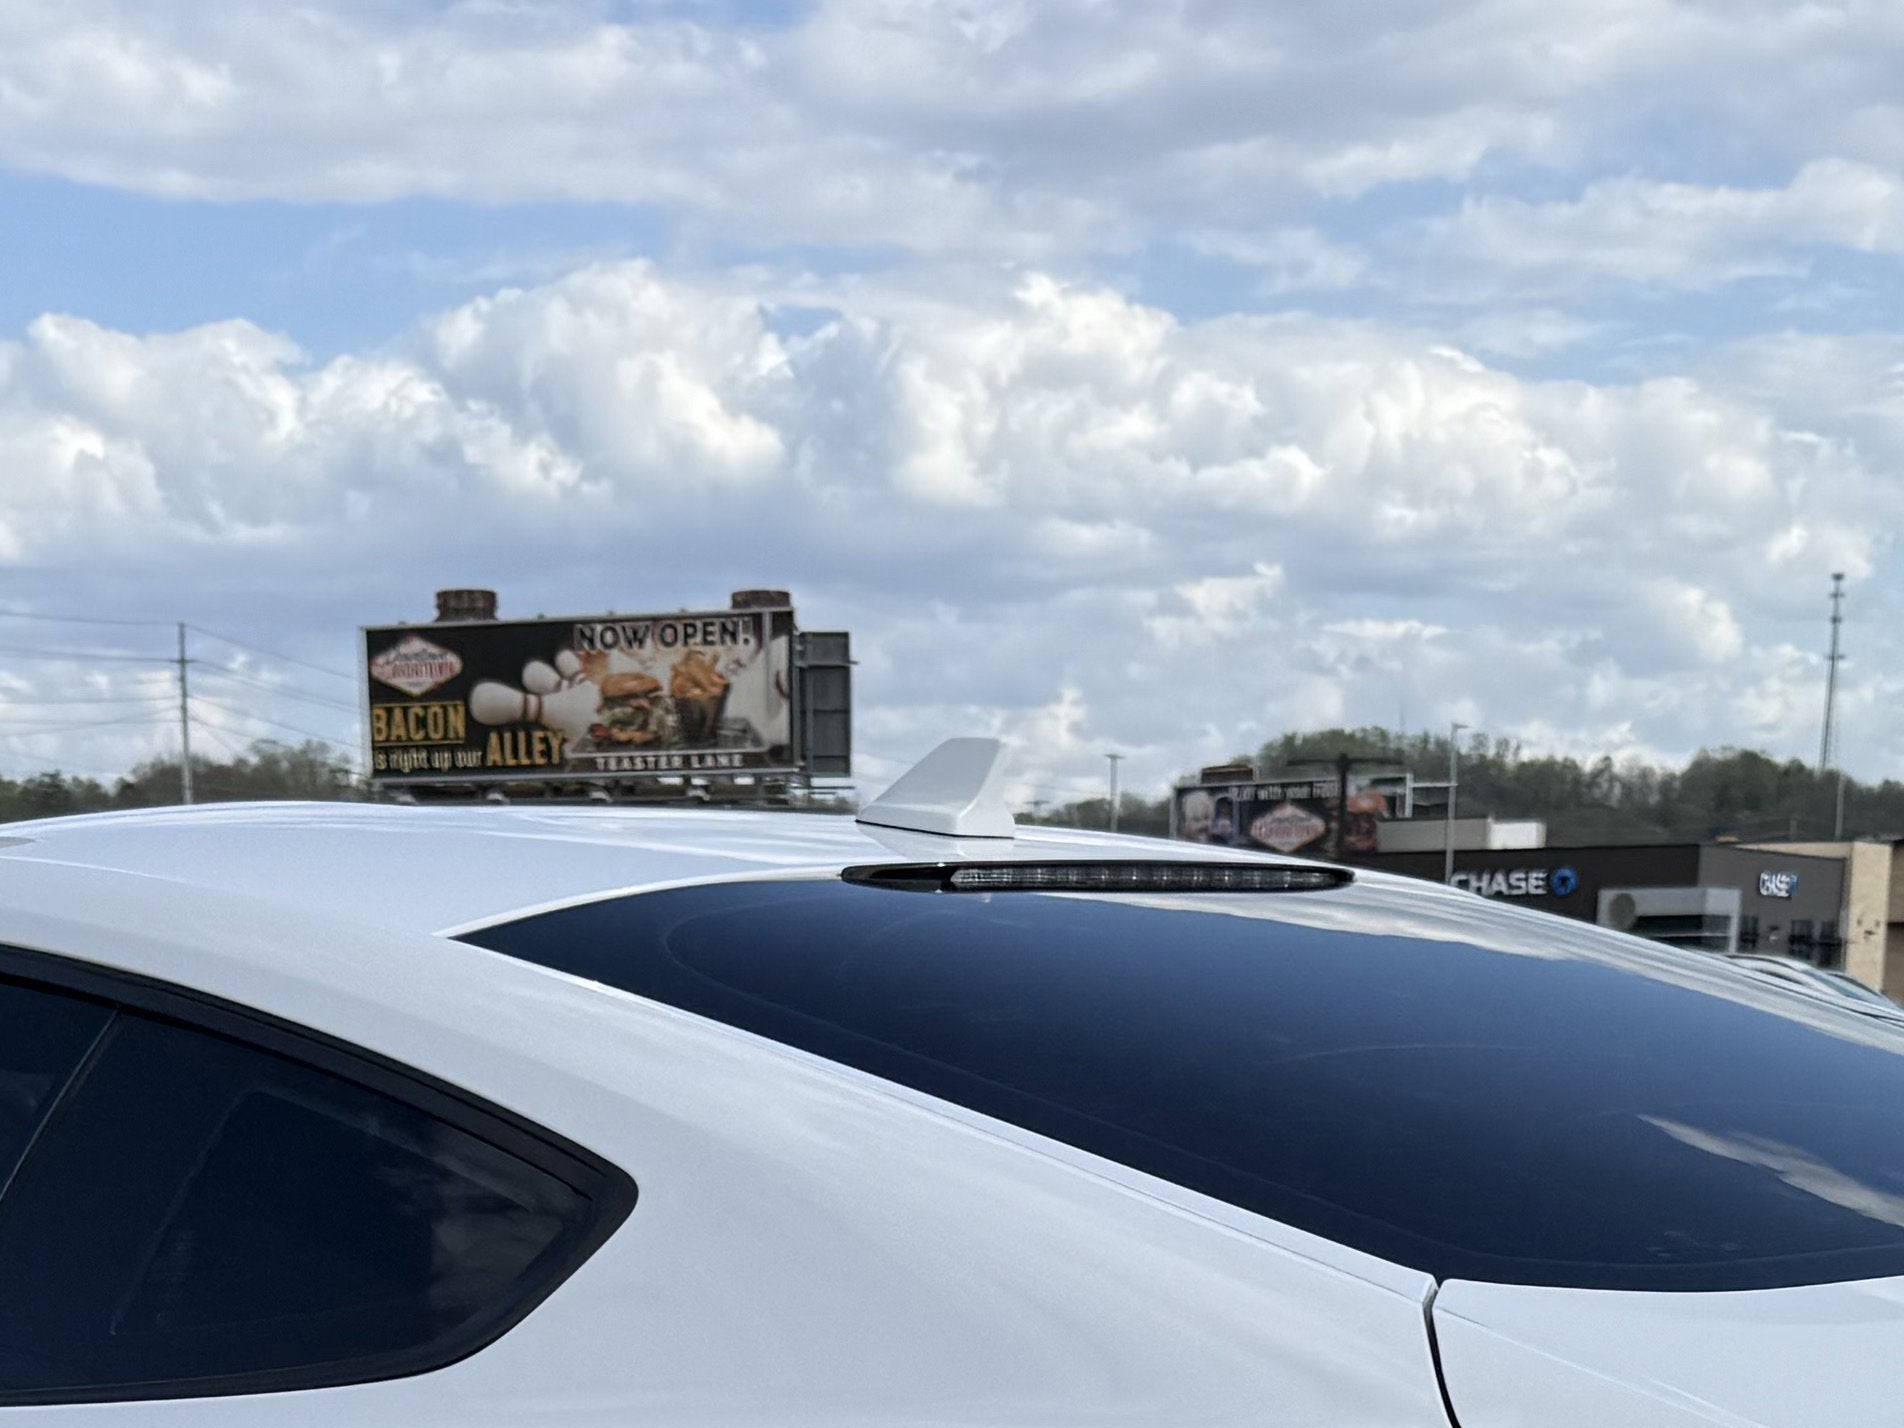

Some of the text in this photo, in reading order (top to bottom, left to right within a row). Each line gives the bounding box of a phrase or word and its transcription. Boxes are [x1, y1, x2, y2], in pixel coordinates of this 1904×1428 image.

[577, 616, 753, 651] NOW OPEN!
[372, 703, 466, 742] BACON
[485, 730, 566, 767] ALLEY
[690, 752, 745, 768] LANE
[1449, 869, 1548, 896] CHASE
